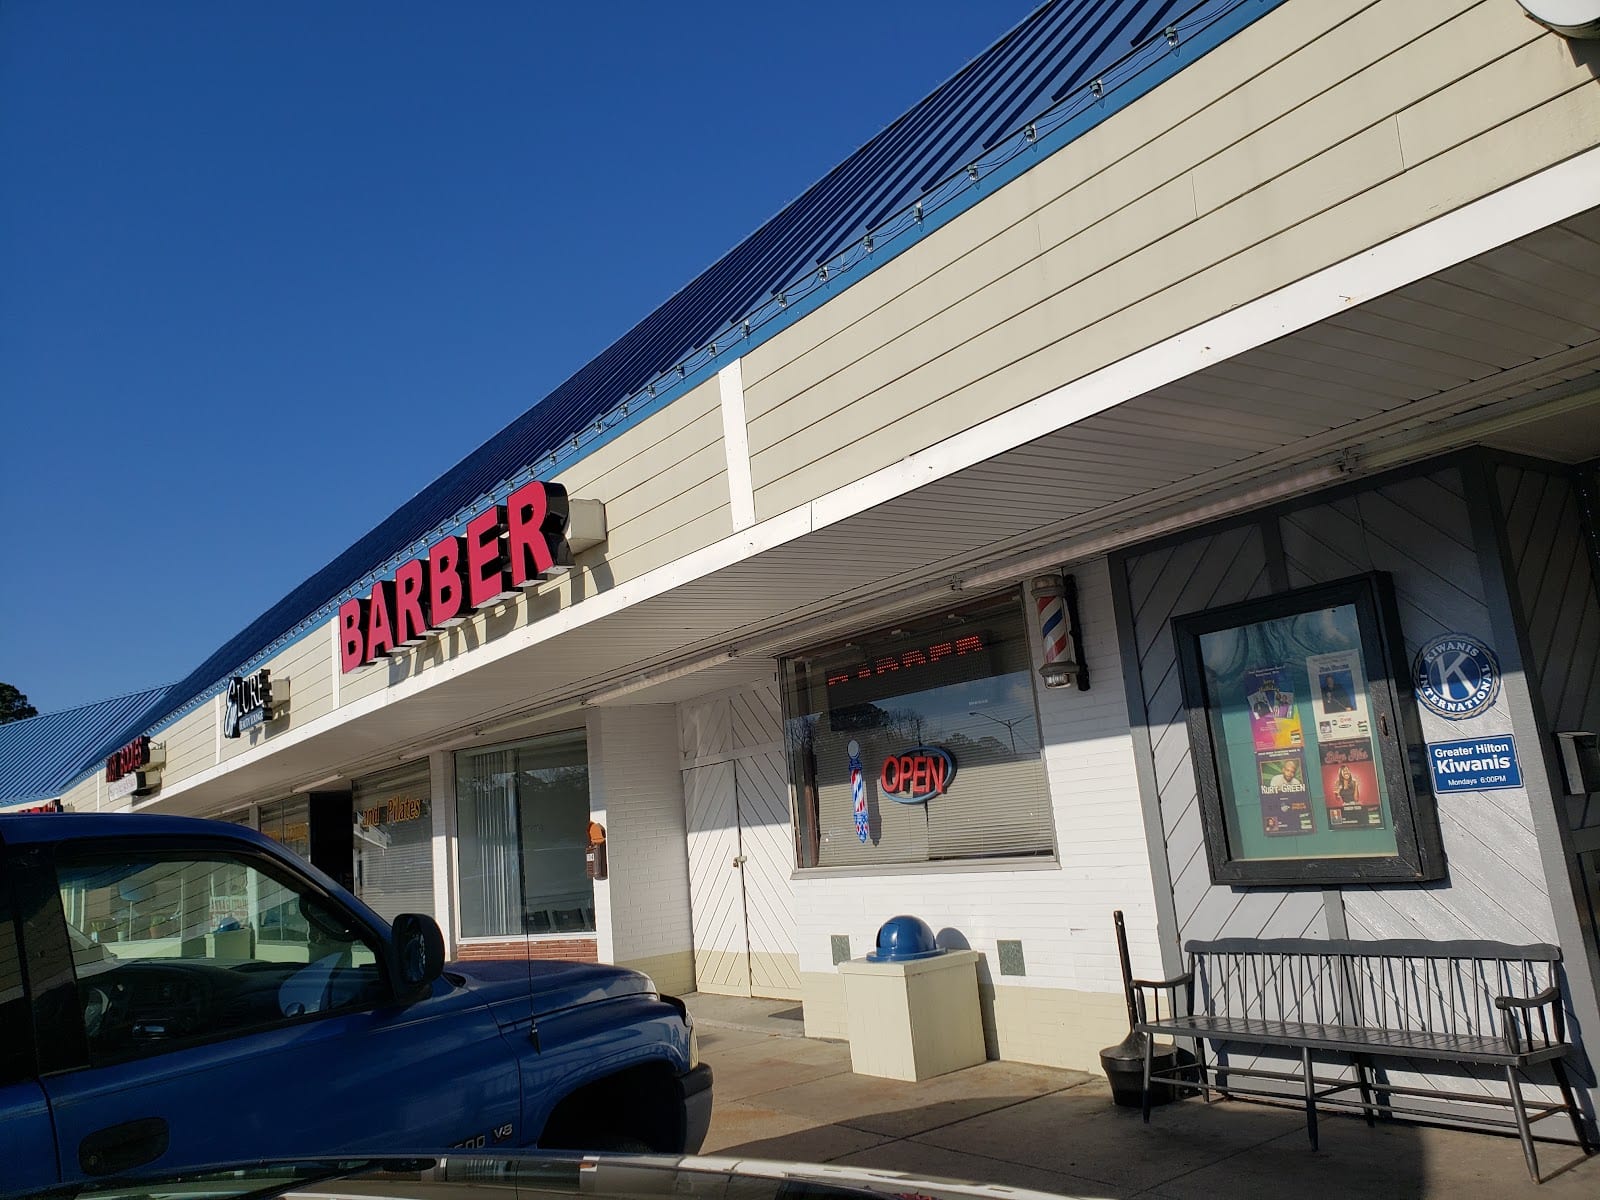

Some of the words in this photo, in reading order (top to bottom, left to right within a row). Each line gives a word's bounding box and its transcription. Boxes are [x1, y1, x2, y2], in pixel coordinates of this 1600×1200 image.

[339, 480, 556, 675] BARBER
[1424, 641, 1480, 663] KIWANIS
[1420, 663, 1493, 711] INTERNATIONAL
[1434, 747, 1474, 758] Greater
[1475, 743, 1510, 754] Hilton
[881, 755, 945, 794] OPEN
[1436, 755, 1511, 774] Kiwanis
[1448, 778, 1478, 787] Mondays
[1480, 775, 1508, 784] 6:00PM
[386, 796, 421, 823] Pilates
[493, 1122, 513, 1138] V8
